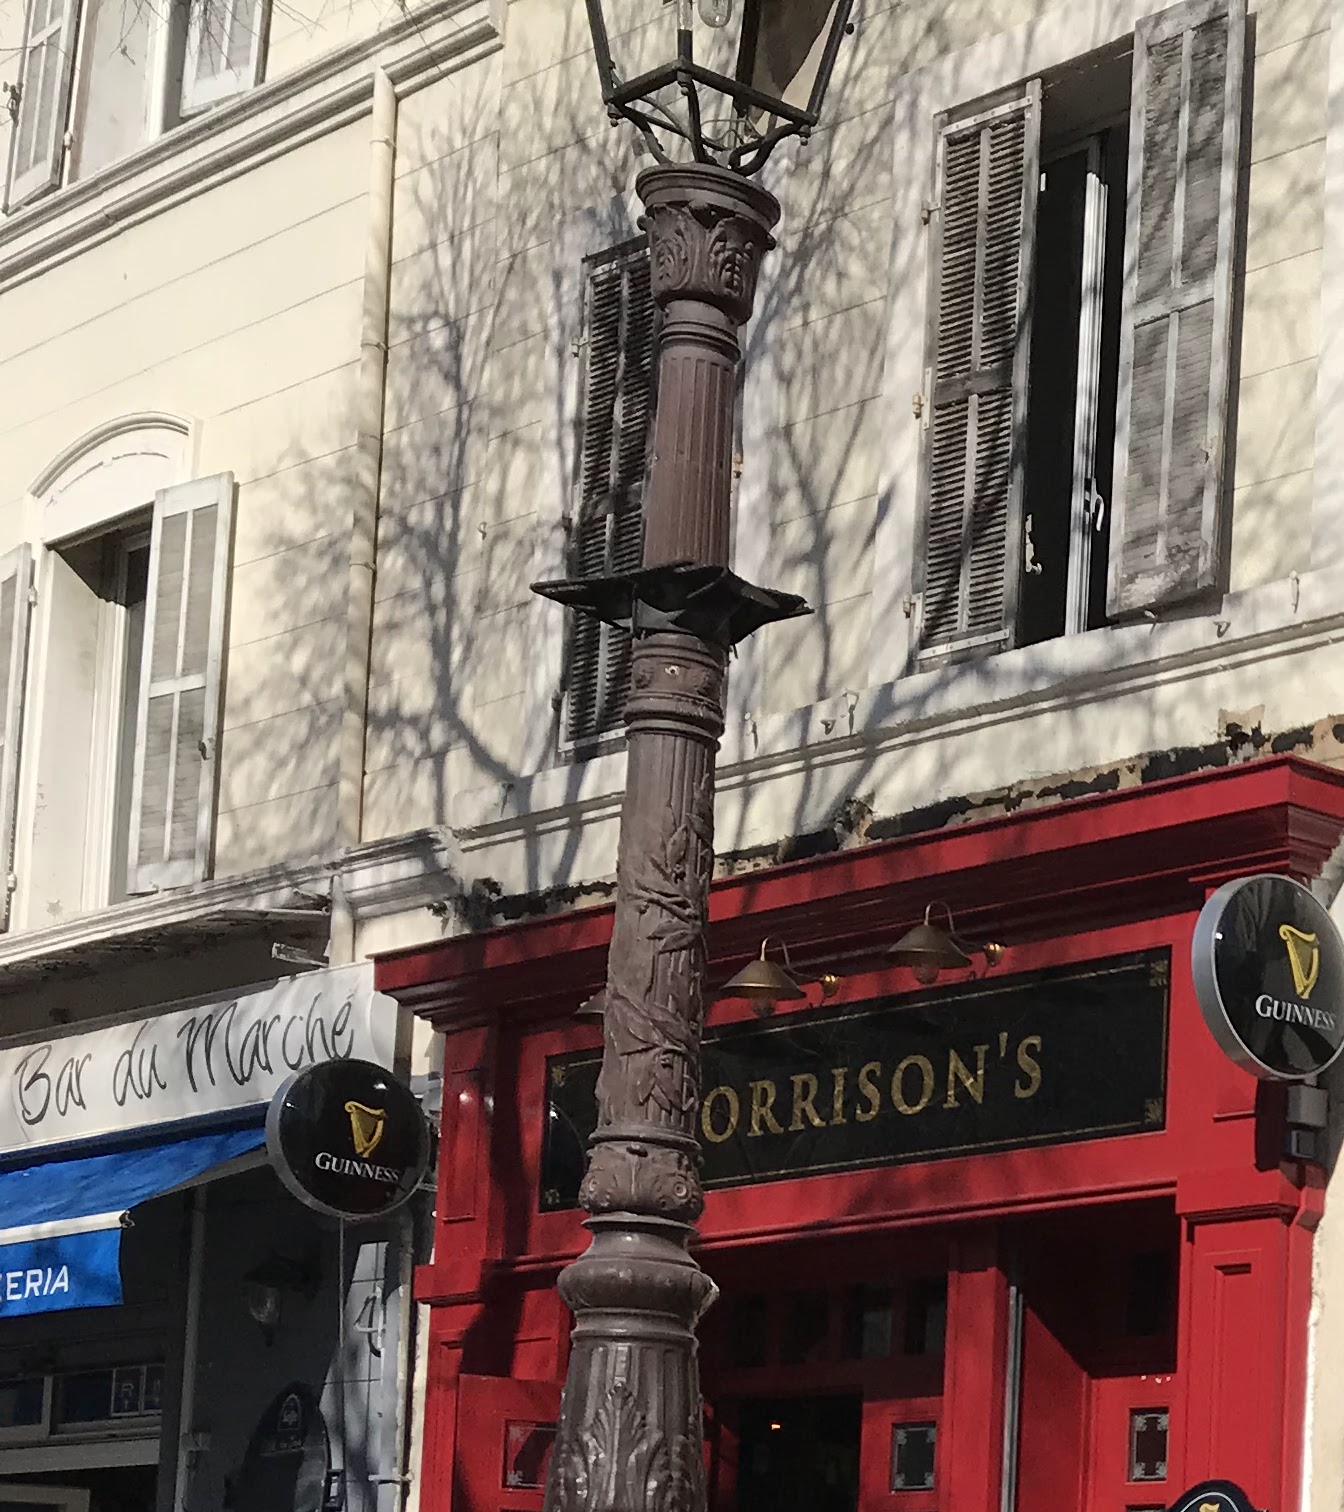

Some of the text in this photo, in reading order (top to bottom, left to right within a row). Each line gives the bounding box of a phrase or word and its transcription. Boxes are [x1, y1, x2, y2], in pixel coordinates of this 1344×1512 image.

[1255, 994, 1337, 1031] GUINNESS
[14, 991, 355, 1126] Bar du Marché
[701, 1032, 1042, 1143] ORRISON'S
[315, 1151, 400, 1182] GUINNESS
[0, 1264, 70, 1301] ERIA
